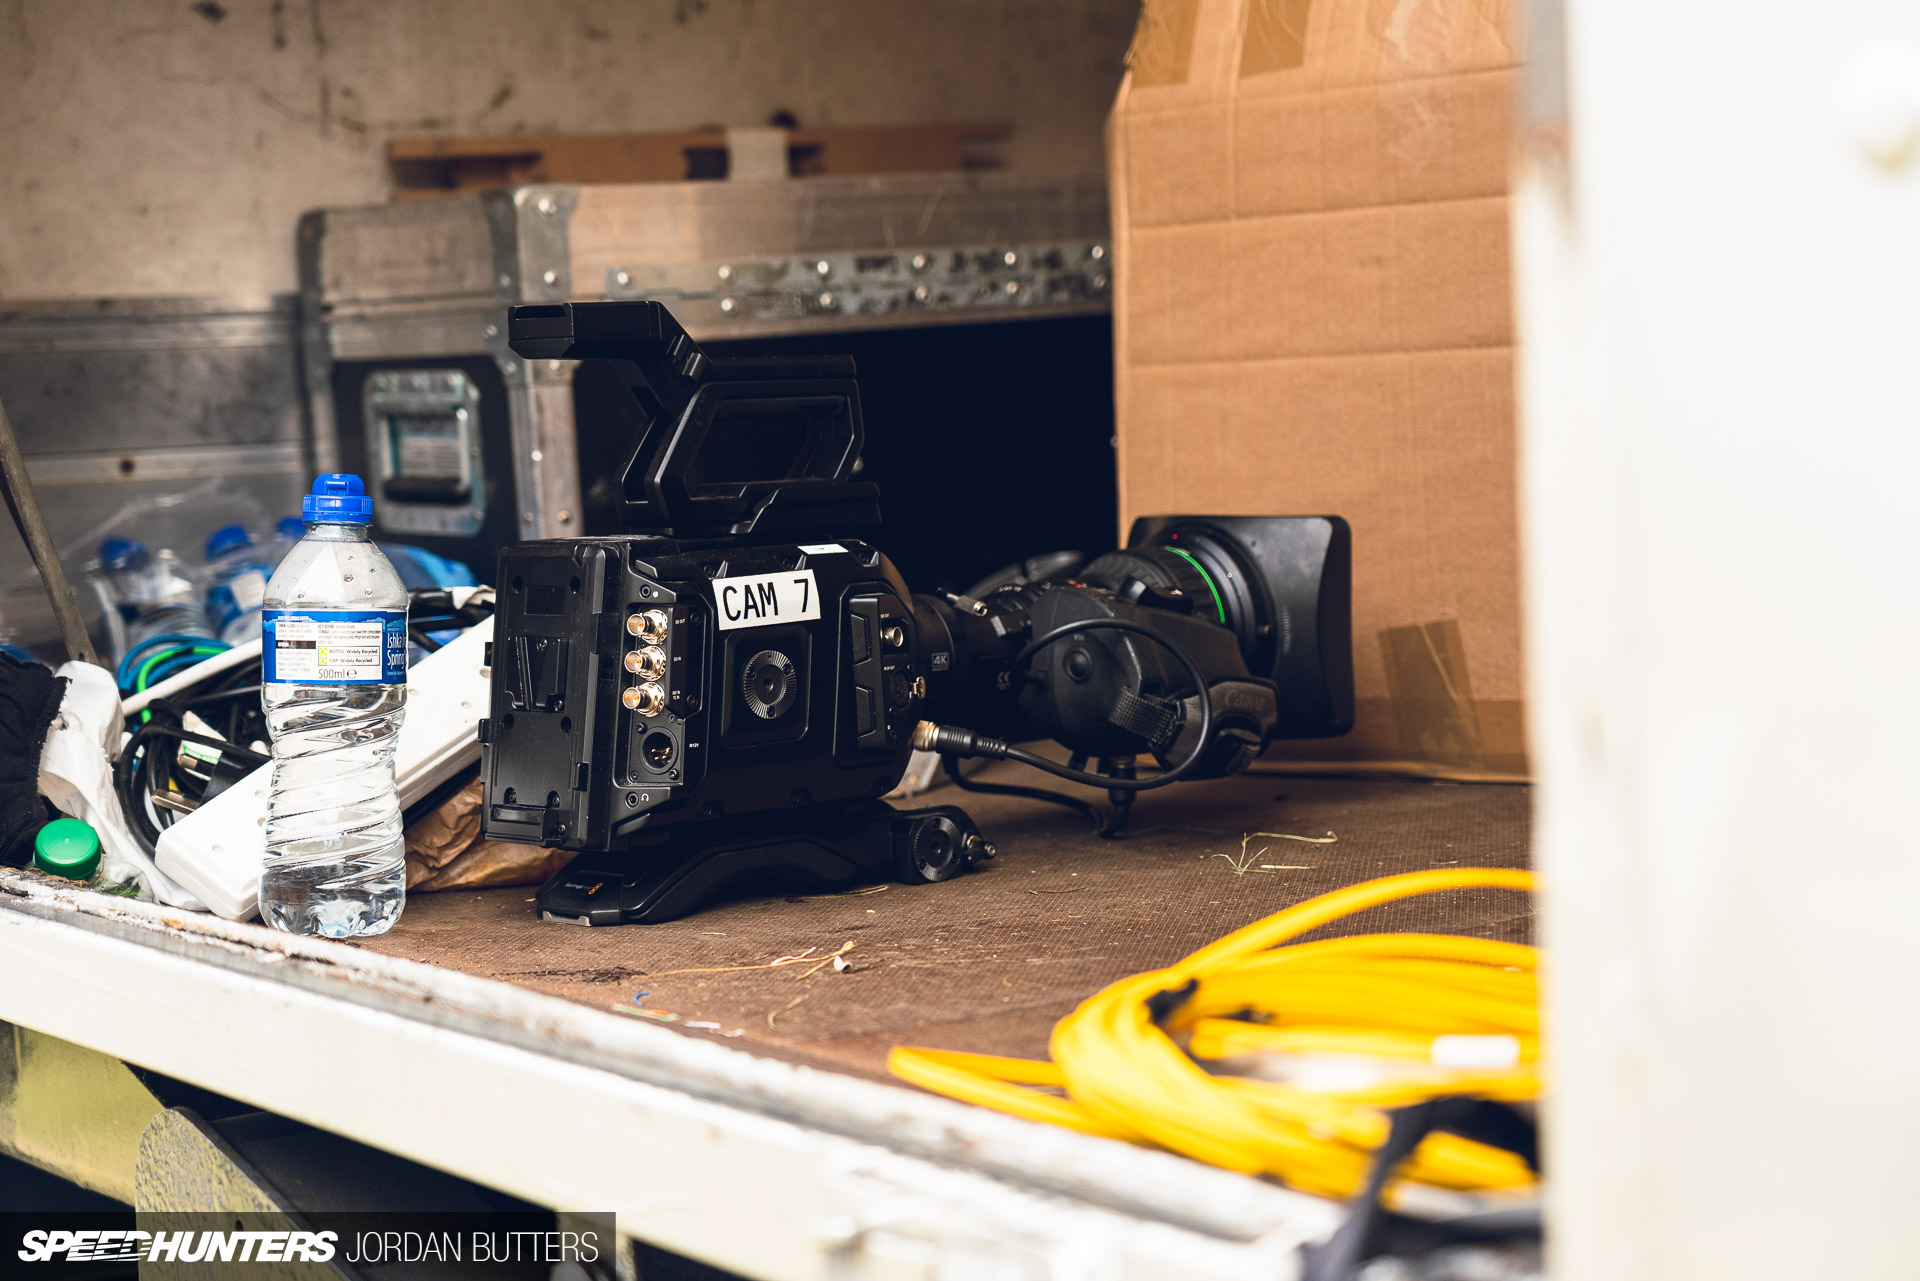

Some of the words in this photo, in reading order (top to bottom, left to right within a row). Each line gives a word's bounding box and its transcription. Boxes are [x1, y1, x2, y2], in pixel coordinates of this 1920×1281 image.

[722, 581, 779, 622] CAM
[793, 578, 809, 613] 7
[387, 632, 402, 649] Ishka
[386, 649, 405, 670] Spring
[933, 654, 948, 666] 4K
[318, 668, 346, 679] 500ml
[1225, 688, 1266, 712] Canon
